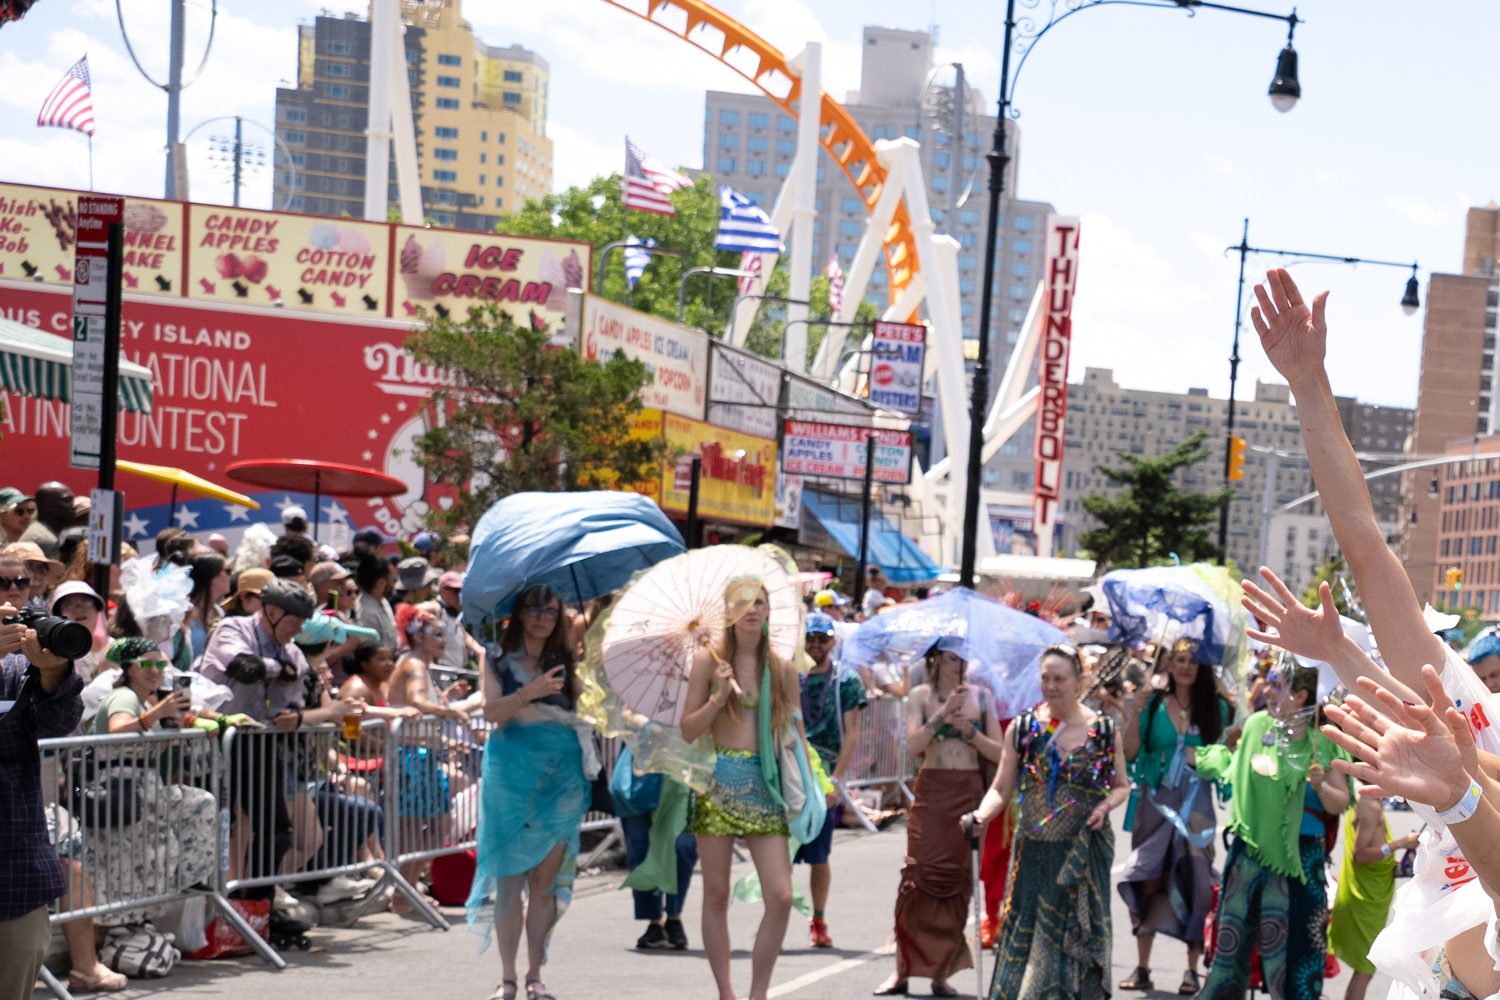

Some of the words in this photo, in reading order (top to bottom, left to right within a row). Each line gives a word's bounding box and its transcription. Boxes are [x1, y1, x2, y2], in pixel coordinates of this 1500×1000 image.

[0, 196, 38, 217] hish
[89, 203, 118, 215] STANDING
[205, 214, 278, 235] CANDY
[124, 232, 176, 251] NNEL
[200, 232, 280, 253] APPLES
[124, 250, 165, 269] AKE
[297, 248, 376, 270] COTTON
[464, 244, 523, 271] ICE
[300, 268, 373, 289] CANDY
[432, 272, 552, 305] CREAM
[154, 323, 251, 350] ISLAND
[600, 315, 624, 341] CANDY
[626, 326, 652, 351] APPLES
[666, 338, 689, 361] CREAM
[877, 322, 923, 340] PETE'S
[875, 342, 921, 363] CLAM
[1035, 226, 1075, 525] THUNDERBOLT
[872, 390, 917, 408] OYSTERS
[117, 404, 248, 456] ONTEST
[791, 421, 858, 441] WILLIAMS
[789, 438, 832, 449] CANDY
[788, 449, 832, 461] APPLES
[806, 462, 844, 475] CREAM
